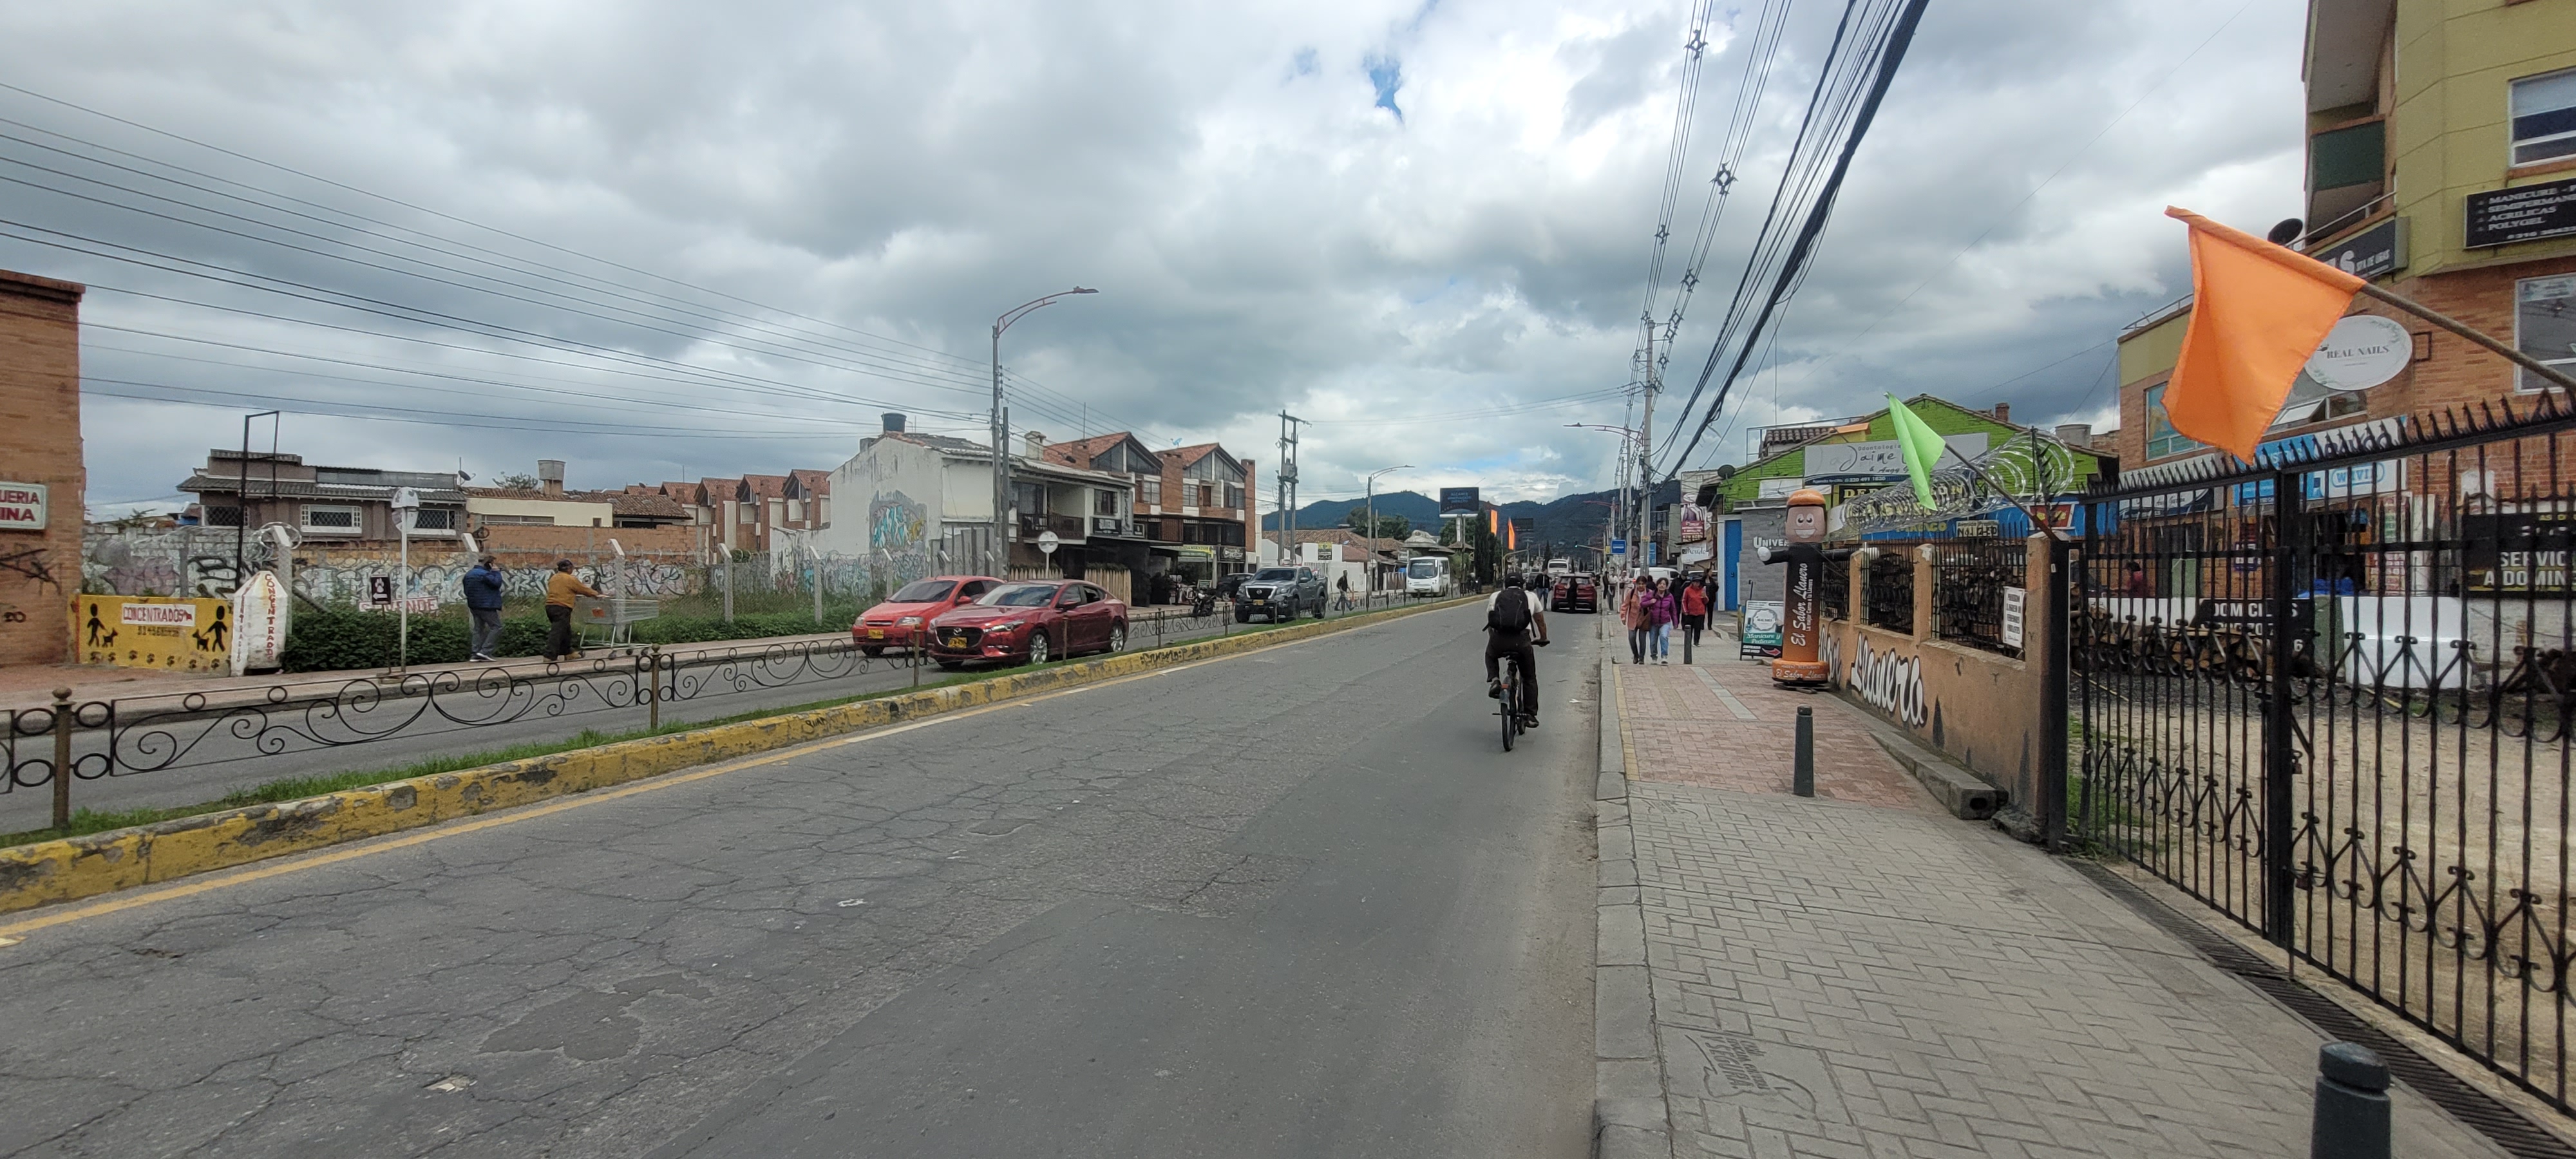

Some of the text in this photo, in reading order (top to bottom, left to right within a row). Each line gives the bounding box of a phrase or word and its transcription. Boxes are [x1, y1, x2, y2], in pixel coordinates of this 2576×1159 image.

[2488, 187, 2557, 204] MANICURE
[2488, 216, 2546, 231] POLYGEL
[2326, 345, 2391, 359] REAL NAILS
